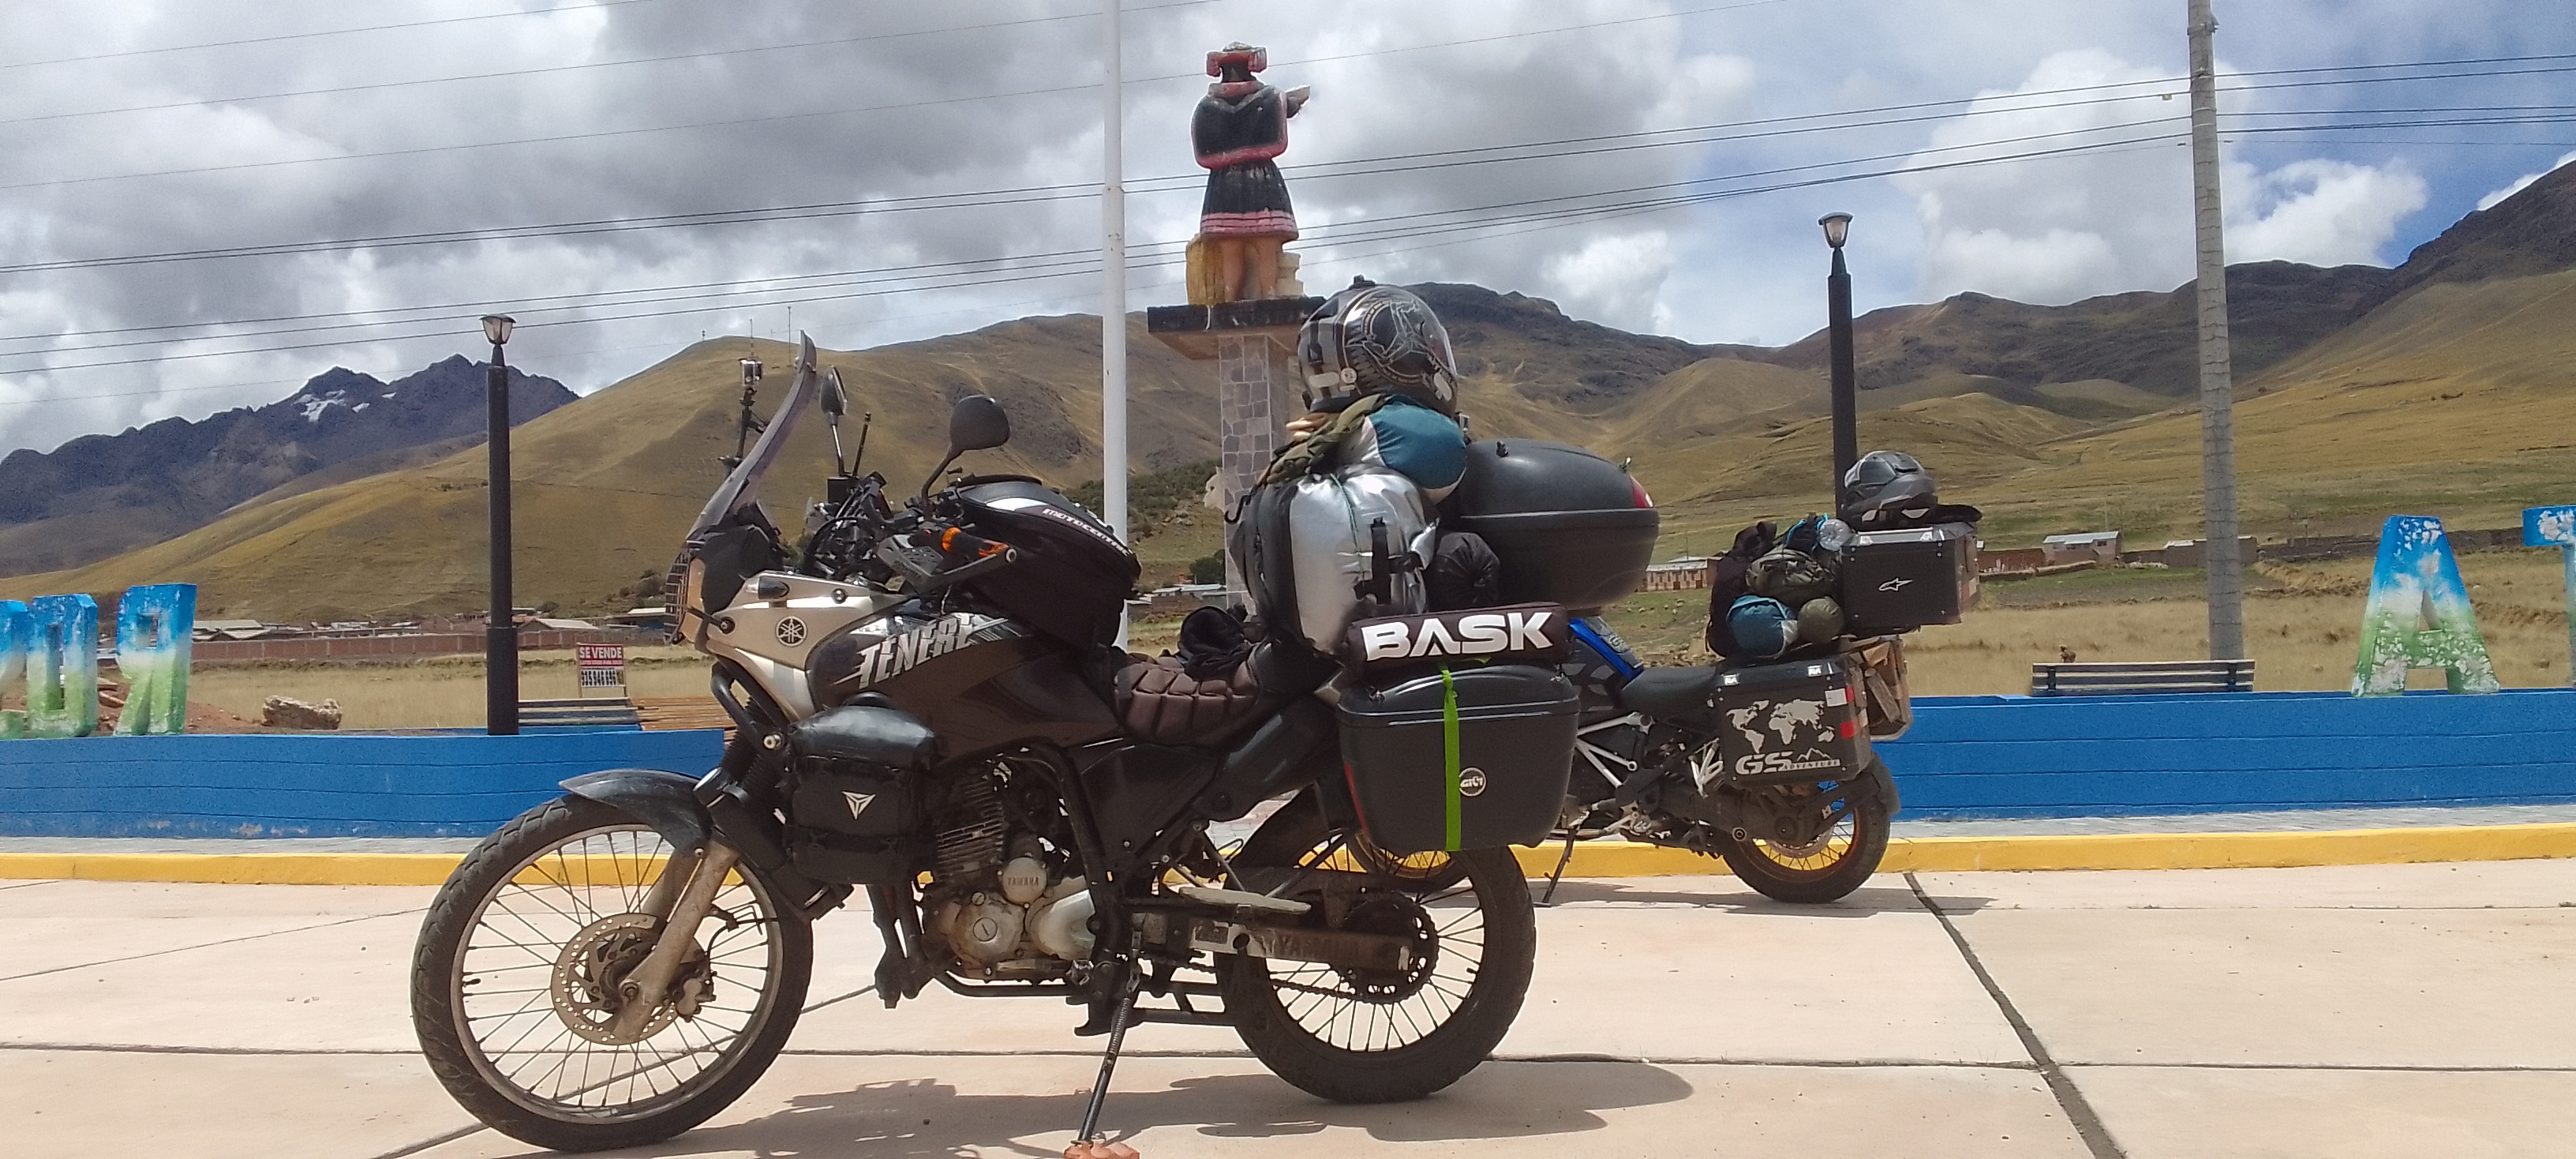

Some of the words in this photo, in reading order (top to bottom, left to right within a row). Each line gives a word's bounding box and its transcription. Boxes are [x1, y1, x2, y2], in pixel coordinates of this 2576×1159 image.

[1361, 612, 1553, 662] BASK
[579, 647, 590, 658] SE
[591, 647, 622, 658] VENDE
[1735, 752, 1794, 775] GS
